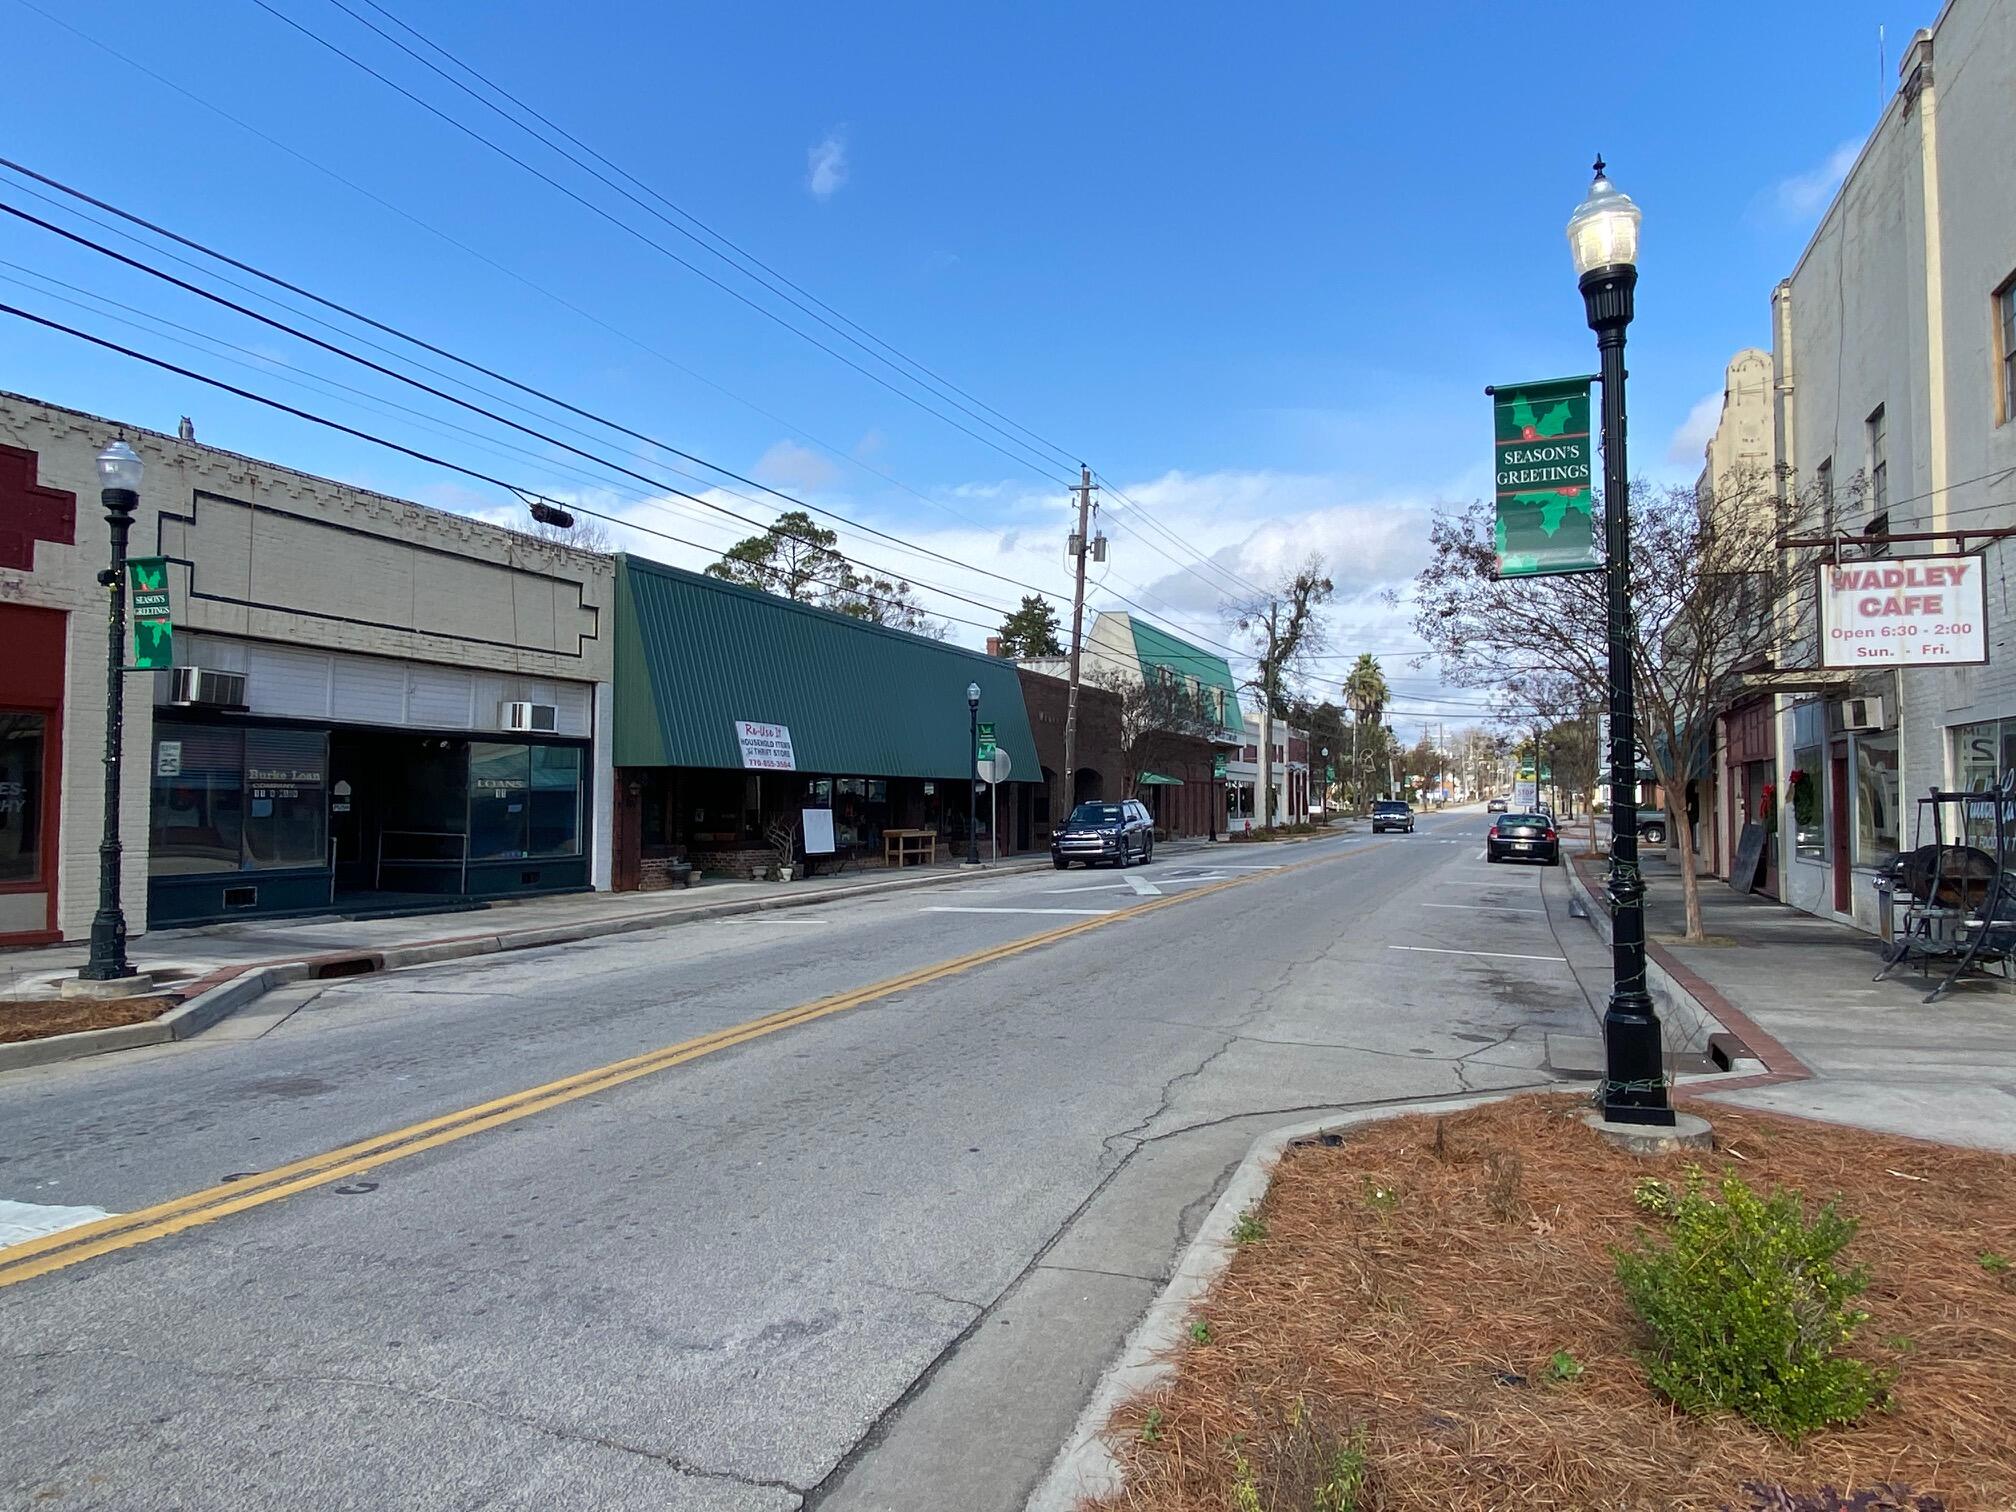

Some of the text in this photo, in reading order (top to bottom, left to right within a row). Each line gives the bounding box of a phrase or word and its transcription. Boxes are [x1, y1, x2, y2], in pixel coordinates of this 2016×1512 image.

[1504, 445, 1580, 465] SEASON'S
[1497, 464, 1589, 485] GREETINGS
[1832, 564, 1971, 592] WADLEY
[135, 595, 166, 605] SEASON'S
[1858, 594, 1944, 617] CAFE
[134, 606, 170, 616] GREETINGS
[1831, 628, 1875, 641] Open
[1881, 625, 1918, 637] 6:30
[1934, 624, 1972, 635] 2:00
[1857, 647, 1894, 658] Sun.
[1922, 644, 1950, 655] Fri.
[745, 724, 774, 738] Re-Use
[741, 738, 775, 748] HOUSEHOLD
[248, 768, 321, 781] Burke Loan
[477, 780, 524, 788] LOANS
